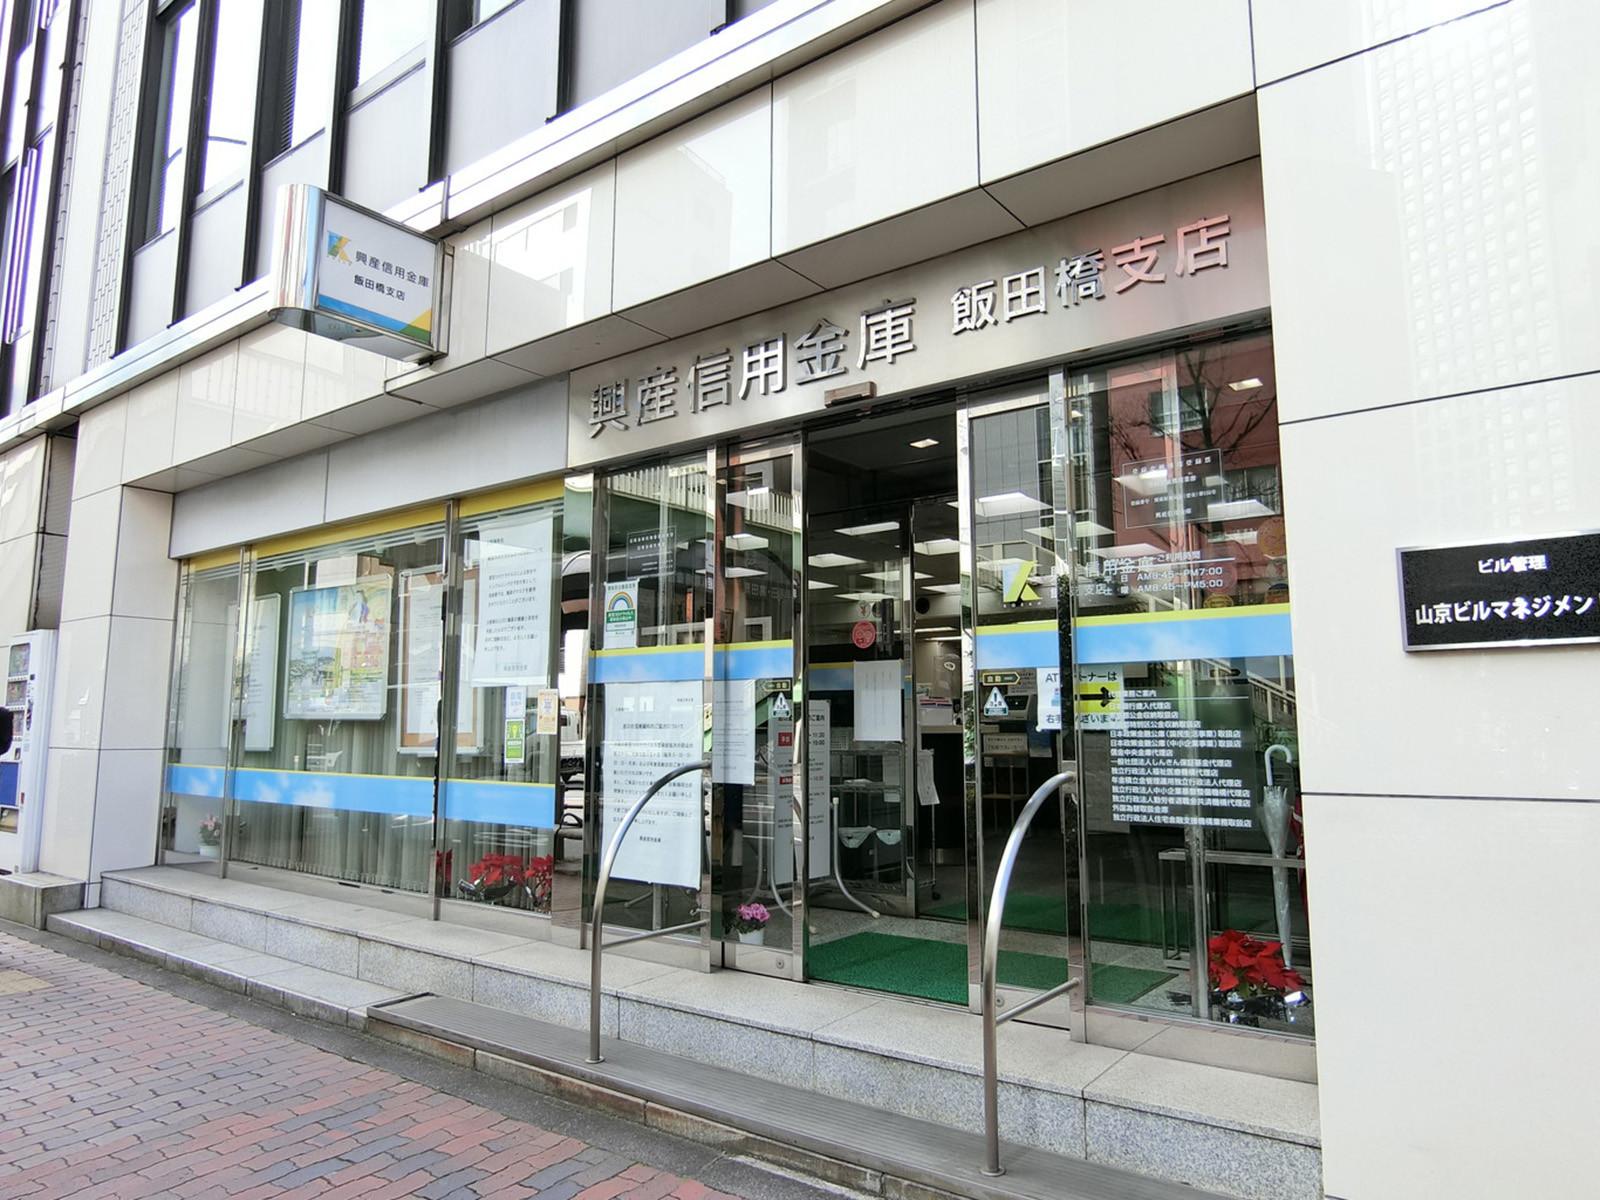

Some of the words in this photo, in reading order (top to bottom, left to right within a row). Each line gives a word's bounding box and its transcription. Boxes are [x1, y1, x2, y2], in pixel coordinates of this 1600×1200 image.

[356, 250, 429, 288] 興産信用金庫
[354, 274, 406, 301] 飯田橋支店
[587, 296, 918, 438] 興産信用金庫
[951, 214, 1232, 335] 飯田橋支店
[1478, 554, 1548, 574] ビル管理
[1416, 594, 1600, 625] 山京ビルマネジメン
